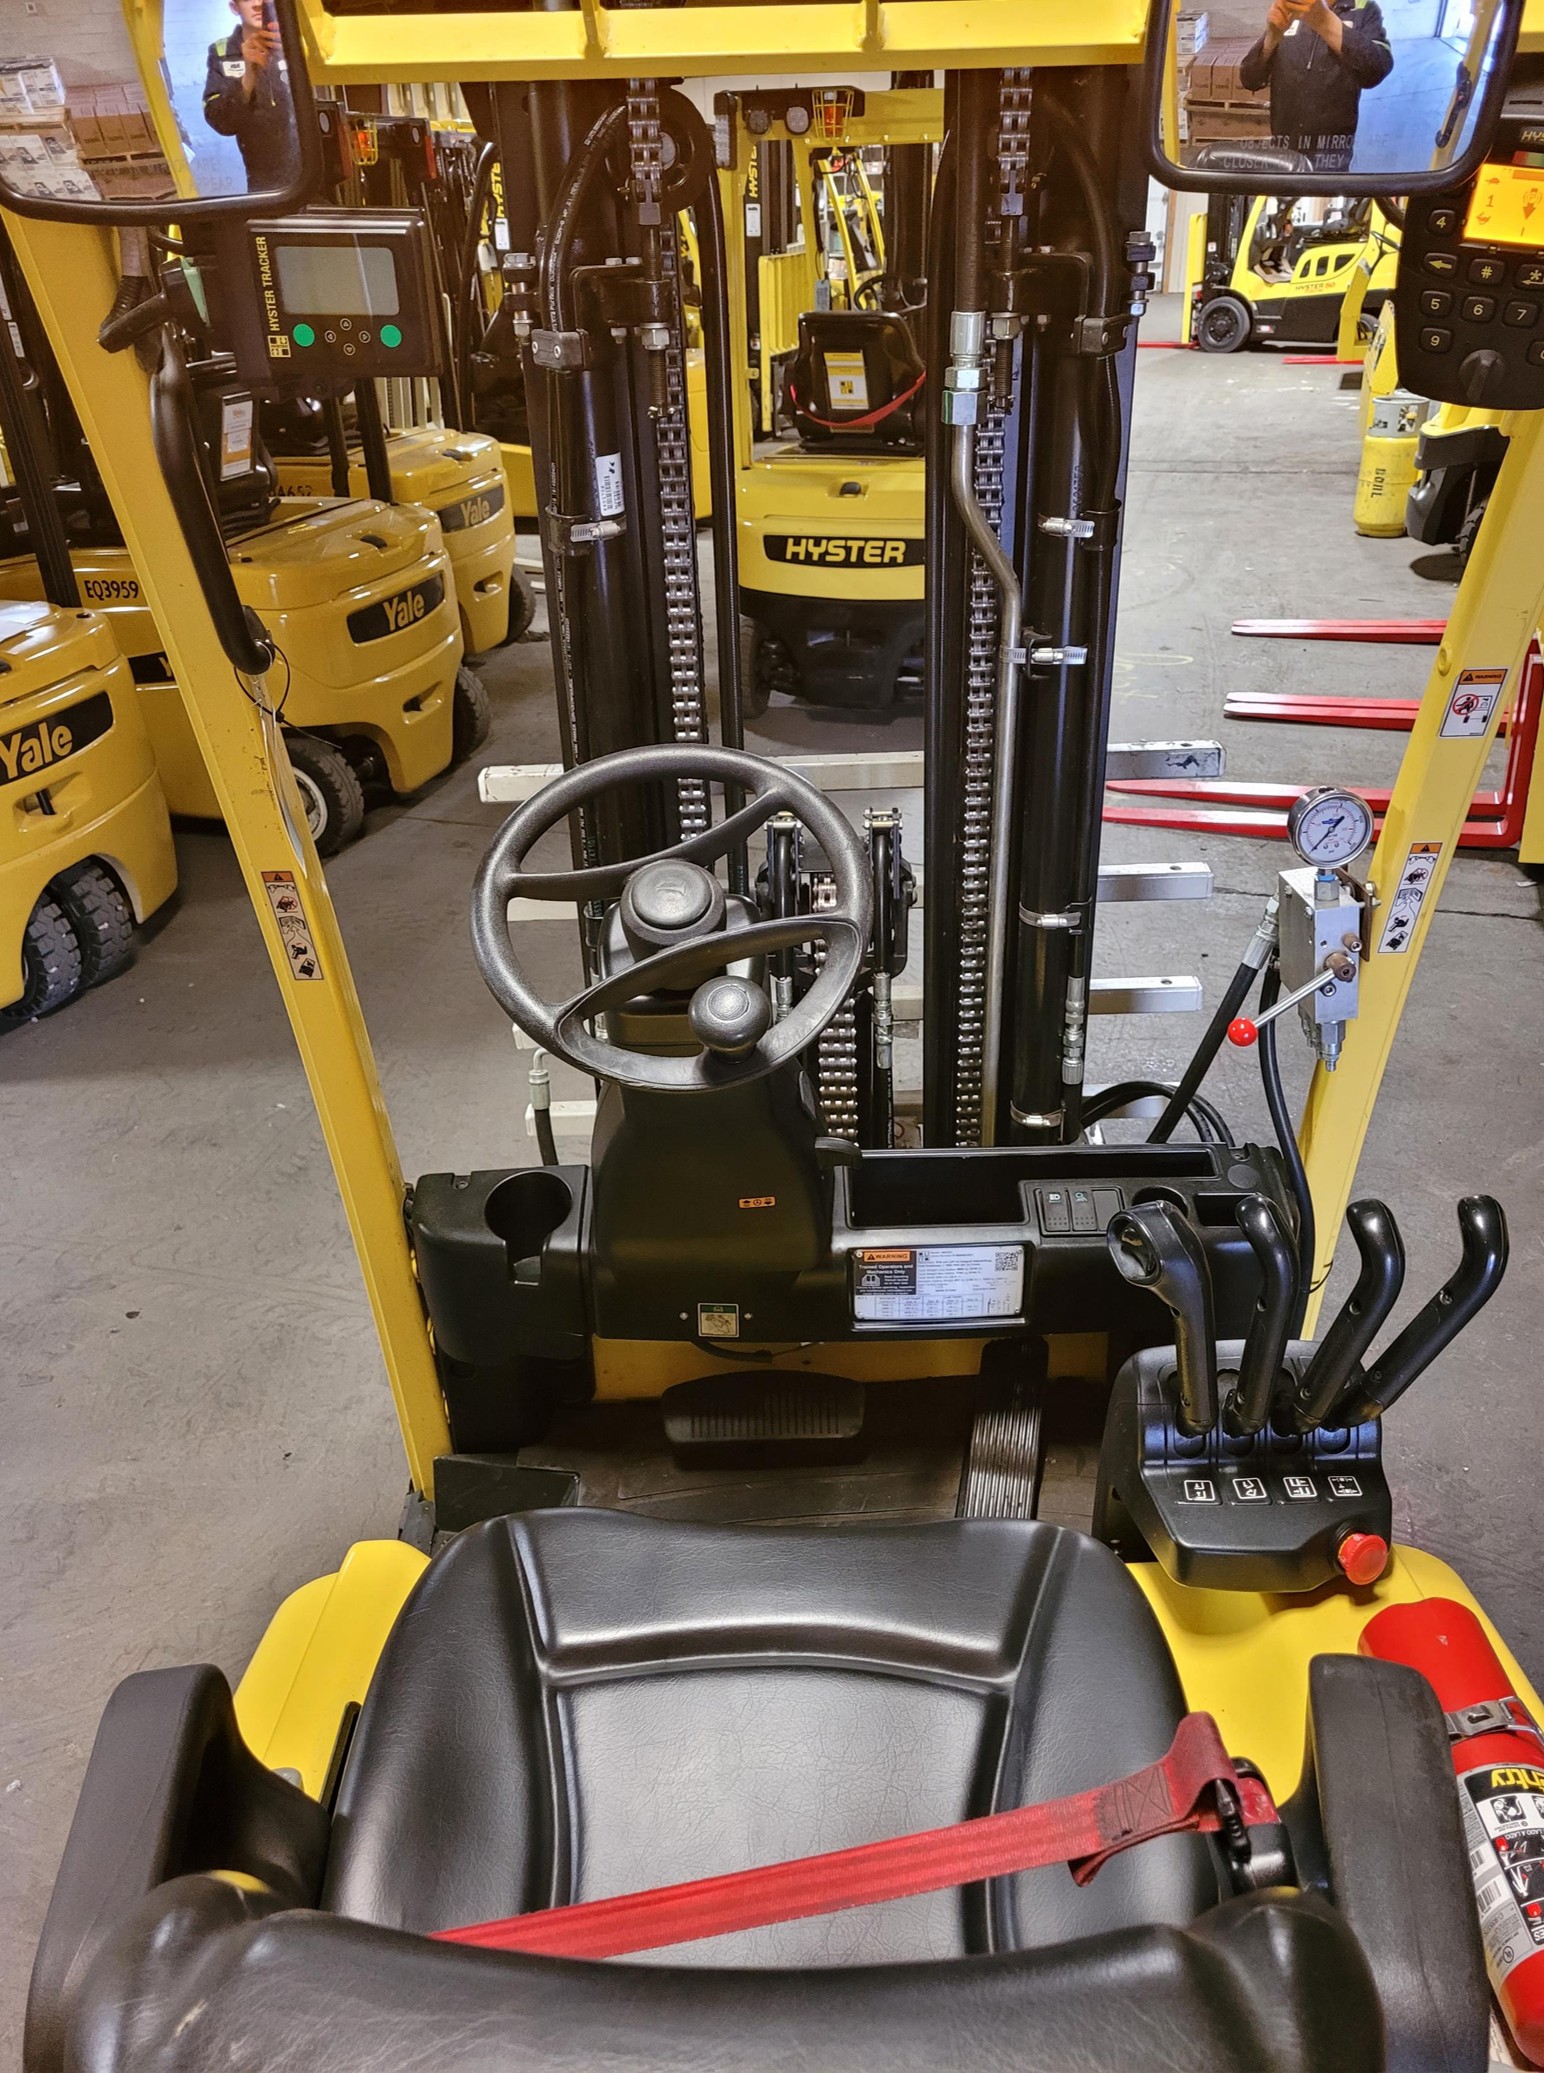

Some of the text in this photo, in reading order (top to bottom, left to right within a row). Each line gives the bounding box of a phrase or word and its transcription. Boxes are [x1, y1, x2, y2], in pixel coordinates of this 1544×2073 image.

[1240, 135, 1290, 149] OBJECTS
[1298, 135, 1311, 149] IN
[1315, 154, 1344, 169] THEY
[1435, 215, 1447, 228] 4
[255, 236, 280, 331] HYSTER TRACKER
[1430, 297, 1440, 310] 5
[1473, 303, 1483, 316] 6
[1516, 309, 1528, 321] 7
[1430, 335, 1440, 347] 9
[460, 498, 490, 528] Yale
[785, 538, 906, 564] HYSTER
[84, 580, 139, 601] EQ3959
[383, 591, 425, 632] Yale
[0, 722, 74, 780] Yale
